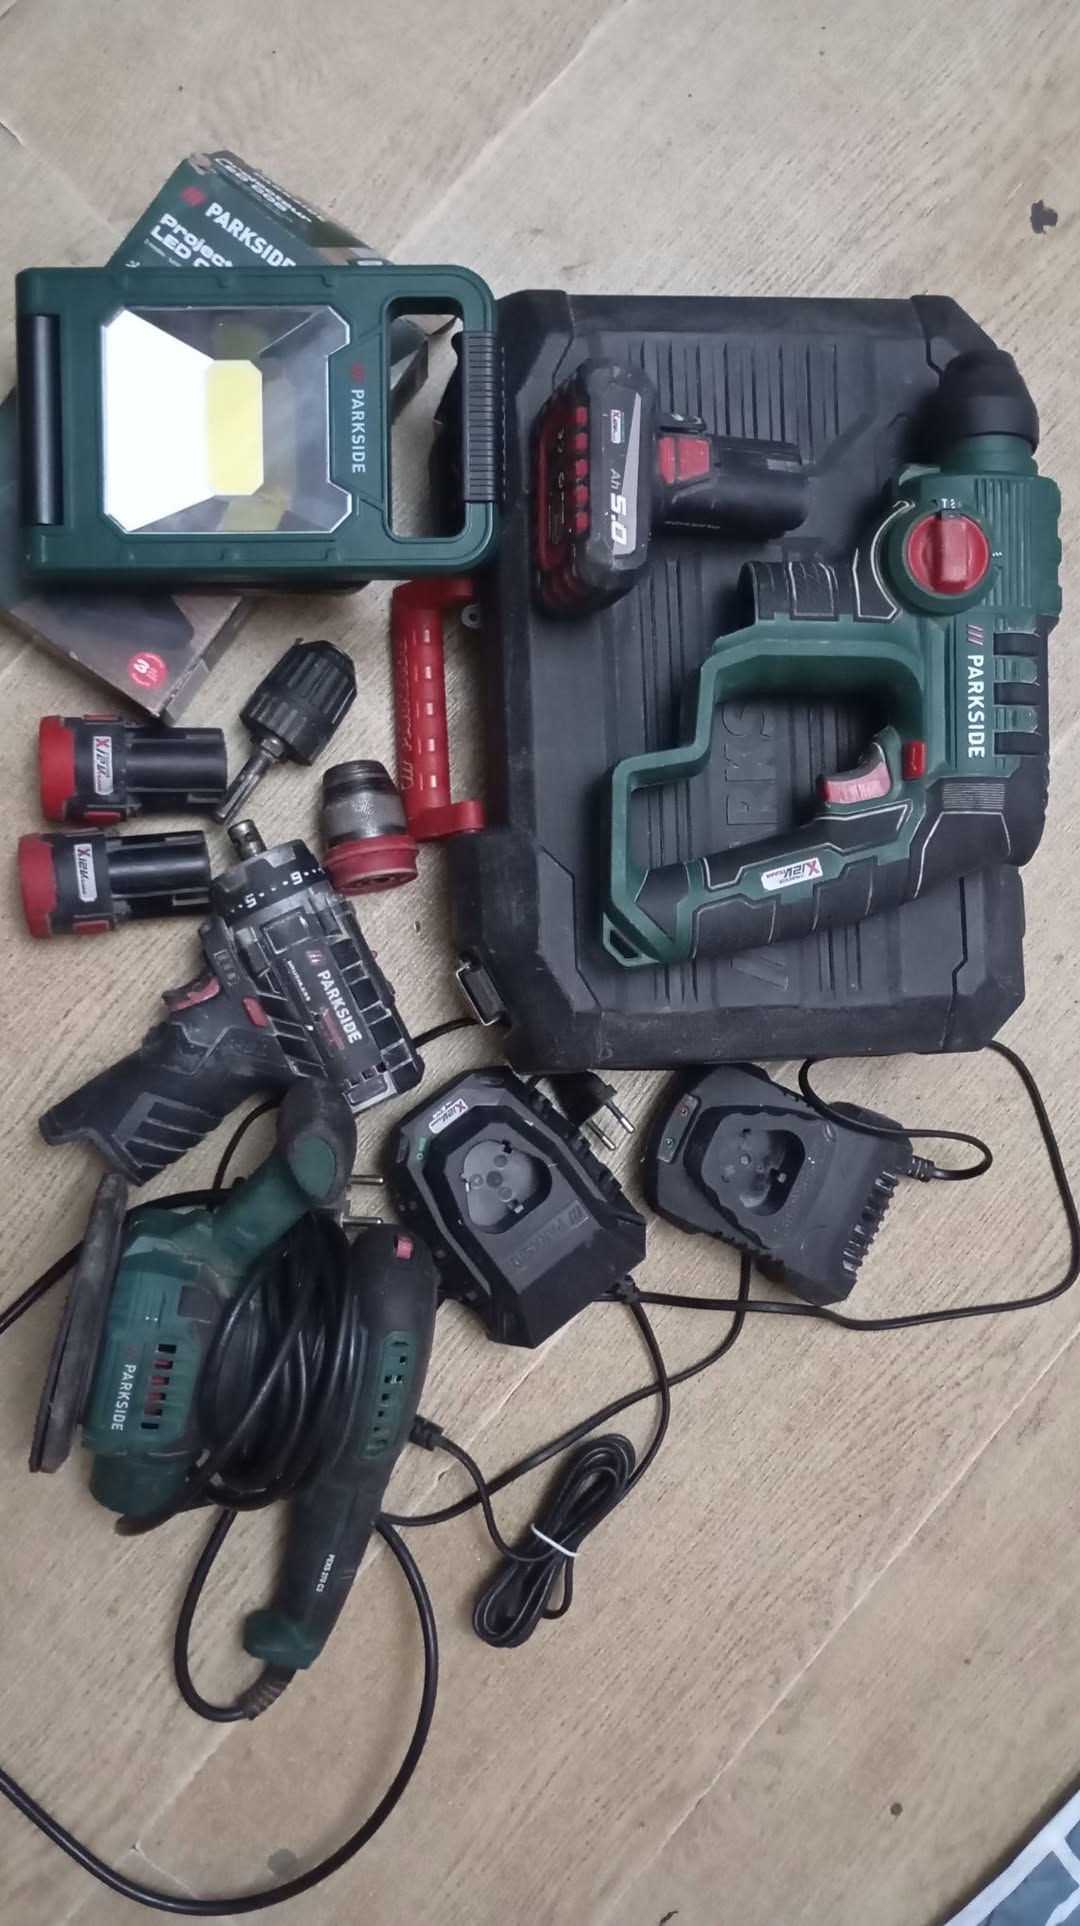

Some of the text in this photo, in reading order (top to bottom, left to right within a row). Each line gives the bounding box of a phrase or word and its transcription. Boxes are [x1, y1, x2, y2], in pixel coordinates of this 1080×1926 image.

[150, 225, 192, 259] LED
[351, 389, 366, 474] PARKSIDE
[609, 468, 627, 545] Ah 5.0
[132, 658, 150, 674] 3
[967, 654, 986, 759] PARKSIDE
[244, 893, 258, 909] 5
[317, 969, 363, 1044] PARKSIDE
[111, 1364, 137, 1431] PARKSIDE
